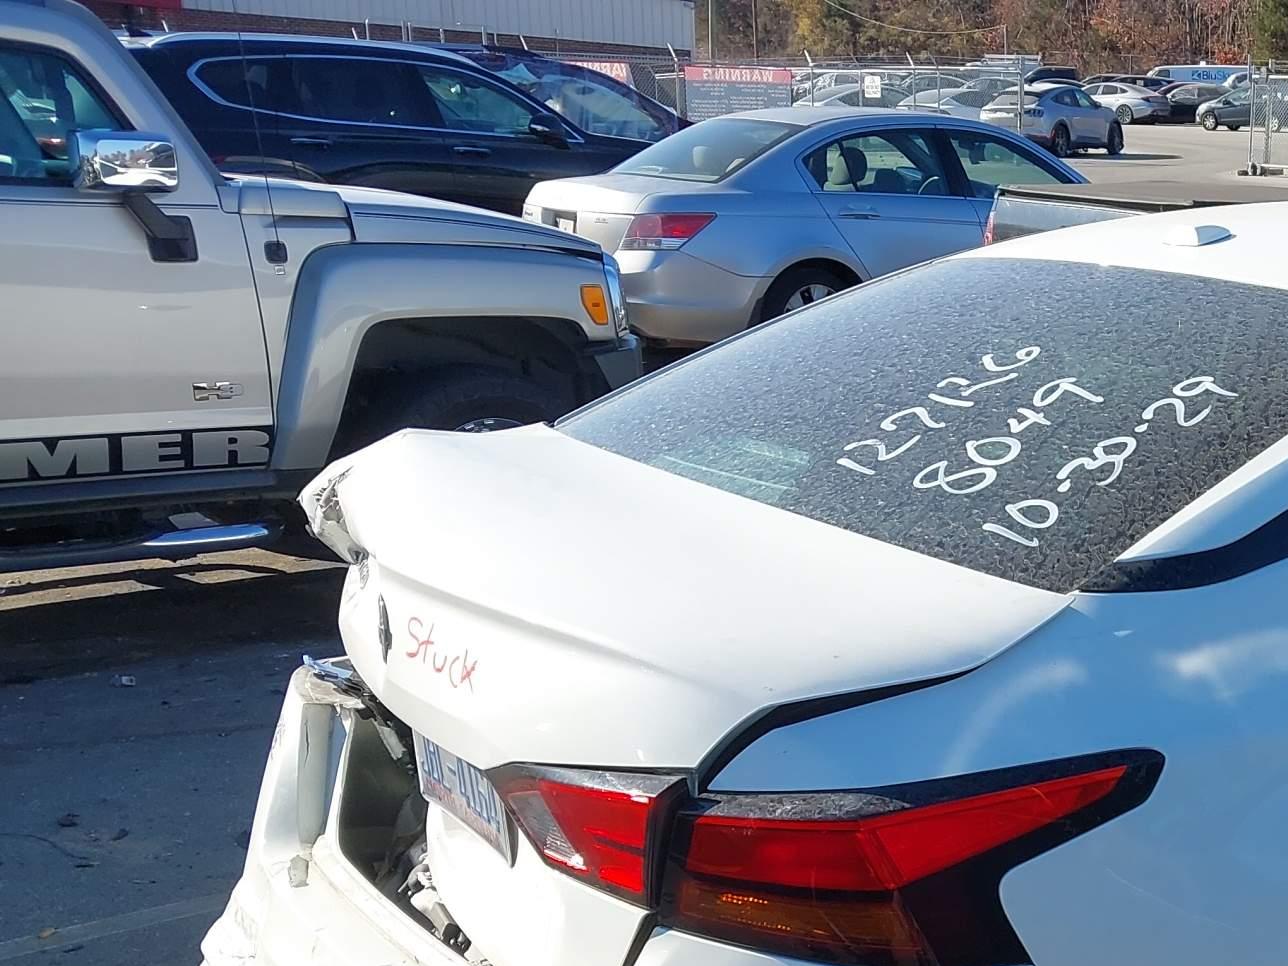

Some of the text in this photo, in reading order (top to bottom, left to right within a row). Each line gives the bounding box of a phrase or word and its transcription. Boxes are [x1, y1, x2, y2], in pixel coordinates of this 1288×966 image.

[191, 381, 246, 402] H3
[911, 377, 1105, 495] 8049
[405, 616, 479, 694] Stuck
